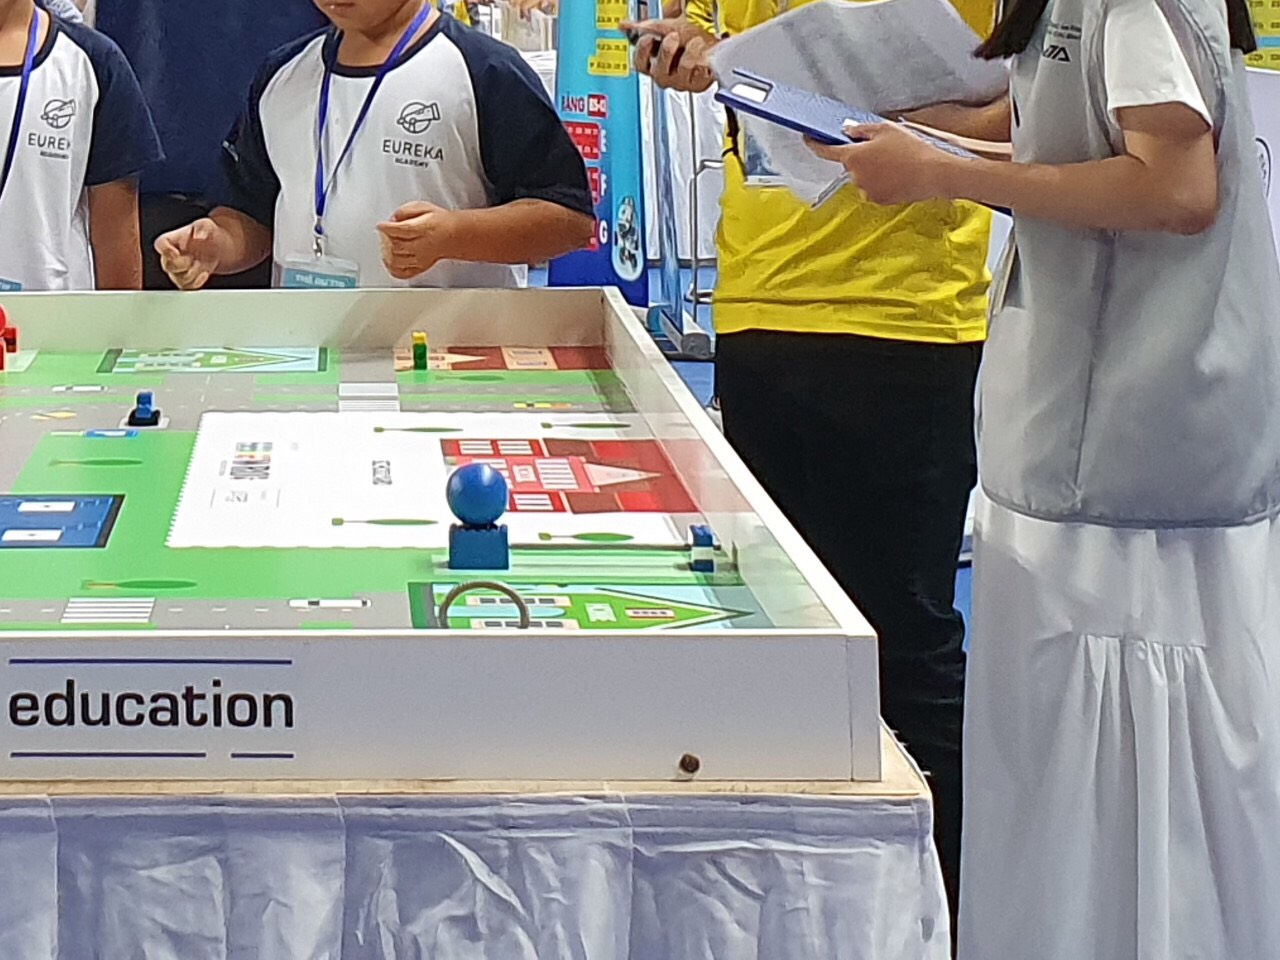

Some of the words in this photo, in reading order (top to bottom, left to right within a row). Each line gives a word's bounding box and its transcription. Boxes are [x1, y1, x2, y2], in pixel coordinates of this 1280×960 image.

[28, 132, 71, 151] EURE
[382, 139, 444, 161] EUREKA
[599, 220, 609, 245] G
[8, 678, 295, 728] education
